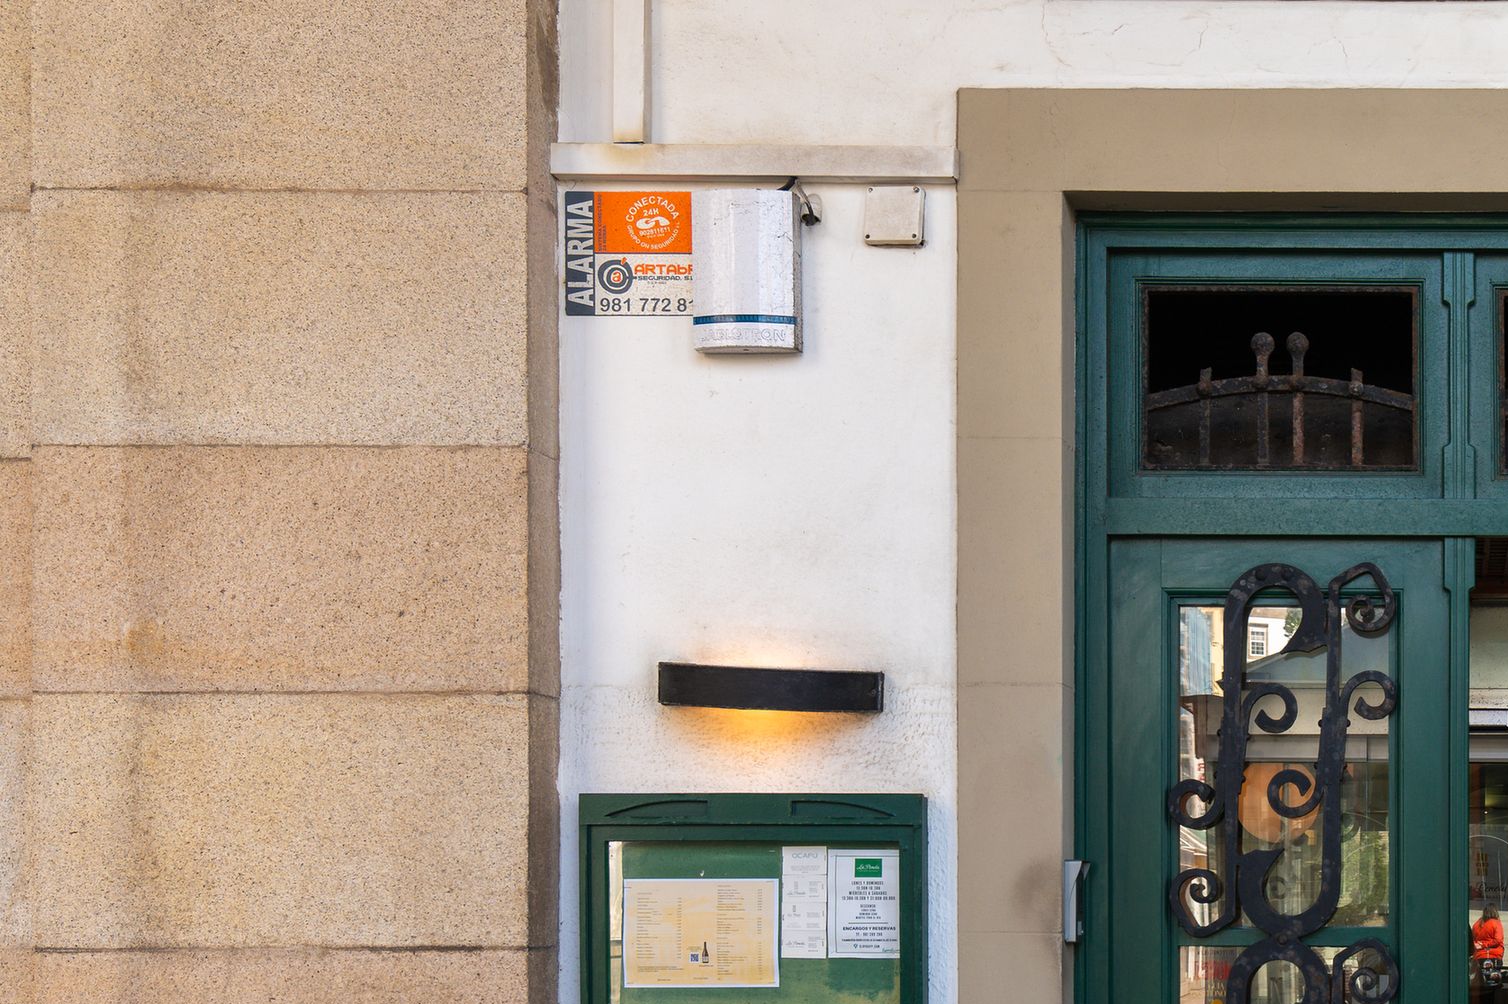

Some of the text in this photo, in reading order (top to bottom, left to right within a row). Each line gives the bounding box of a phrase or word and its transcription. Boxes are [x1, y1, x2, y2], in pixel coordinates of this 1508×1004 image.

[625, 195, 680, 222] CONECTADA
[643, 207, 660, 217] 24H
[566, 200, 594, 307] ALARMA
[600, 298, 631, 312] 981
[639, 298, 671, 312] 772
